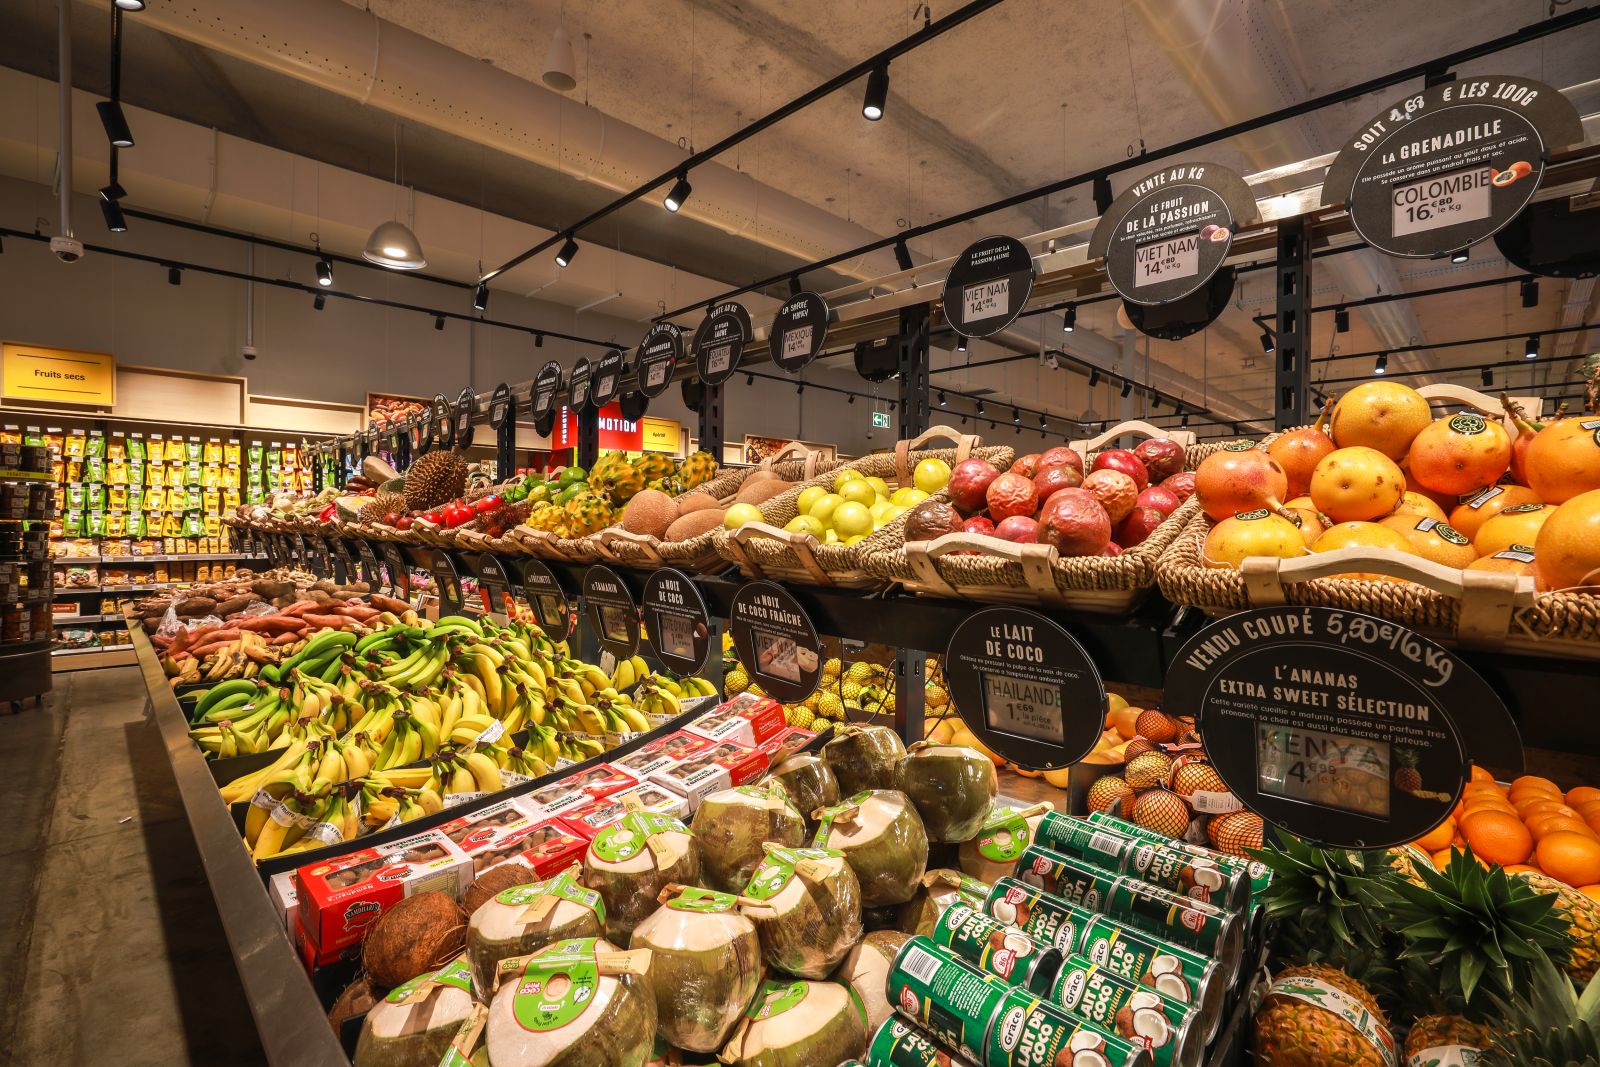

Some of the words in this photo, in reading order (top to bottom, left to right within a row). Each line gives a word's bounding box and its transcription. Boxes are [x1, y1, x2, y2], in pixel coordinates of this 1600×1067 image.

[1353, 122, 1386, 151] SOIT
[1460, 82, 1489, 99] LES
[1493, 82, 1537, 106] 100G
[1382, 152, 1395, 164] LA
[1400, 119, 1502, 159] GRENADILLE
[1427, 156, 1452, 167] puissant
[1481, 144, 1496, 152] doux
[1508, 137, 1528, 145] acide.
[1132, 173, 1165, 197] VENTE
[1170, 168, 1185, 181] AU
[1188, 167, 1204, 180] KG
[1390, 173, 1415, 182] conserve
[1442, 160, 1464, 169] endroit
[1394, 169, 1489, 207] COLOMBIE
[1127, 220, 1138, 233] DE
[1143, 215, 1155, 228] LA
[1160, 201, 1209, 223] PASSION
[1150, 204, 1159, 213] LE
[1161, 197, 1183, 210] FRUIT
[971, 257, 992, 265] PASSION
[979, 249, 994, 257] FRUIT
[1137, 245, 1161, 262] VIET
[1168, 238, 1198, 255] NAM
[966, 288, 984, 301] VIET
[34, 369, 61, 379] Fruits
[660, 581, 665, 589] LA
[665, 579, 680, 591] NOIX
[659, 591, 666, 601] DE
[668, 593, 683, 604] COCO
[754, 596, 761, 604] LA
[762, 595, 779, 608] NOIX
[738, 603, 747, 614] DE
[749, 605, 767, 618] COCO
[770, 610, 802, 626] FRAÎCHE
[991, 626, 1000, 637] LE
[1004, 624, 1033, 642] LAIT
[1186, 628, 1240, 671] VENDU
[1243, 609, 1313, 639] COUPÉ
[986, 641, 1001, 657] DE
[1007, 645, 1043, 663] COCO
[985, 679, 1061, 707] THAILANDE
[1220, 679, 1266, 699] EXTRA
[1274, 686, 1328, 708] SWEET
[1338, 686, 1429, 721] SÉLECTION
[1211, 698, 1230, 706] Cette
[1233, 702, 1258, 710] variété
[1261, 706, 1288, 714] cueillie
[1299, 712, 1333, 722] maturité
[1337, 717, 1372, 728] possède
[1389, 725, 1423, 735] parfum
[1307, 723, 1328, 731] aussi
[1331, 726, 1348, 734] plus
[1351, 729, 1379, 739] sucrée
[1395, 736, 1432, 747] juteuse.
[1261, 729, 1384, 768] KENYA
[1139, 847, 1152, 867] Grace
[1161, 853, 1177, 878] COCO
[1149, 857, 1163, 882] LAIT
[958, 917, 977, 941] LAIT
[972, 917, 992, 938] COCO
[1044, 911, 1062, 939] LAIT
[1112, 941, 1127, 958] DE
[1066, 974, 1082, 1004] Grace
[1088, 972, 1105, 993] DE
[1093, 985, 1112, 1021] COCO
[1005, 1011, 1021, 1045] Grace
[1018, 1028, 1035, 1067] LAIT
[1028, 1011, 1046, 1029] DE
[1032, 1024, 1053, 1064] COCO
